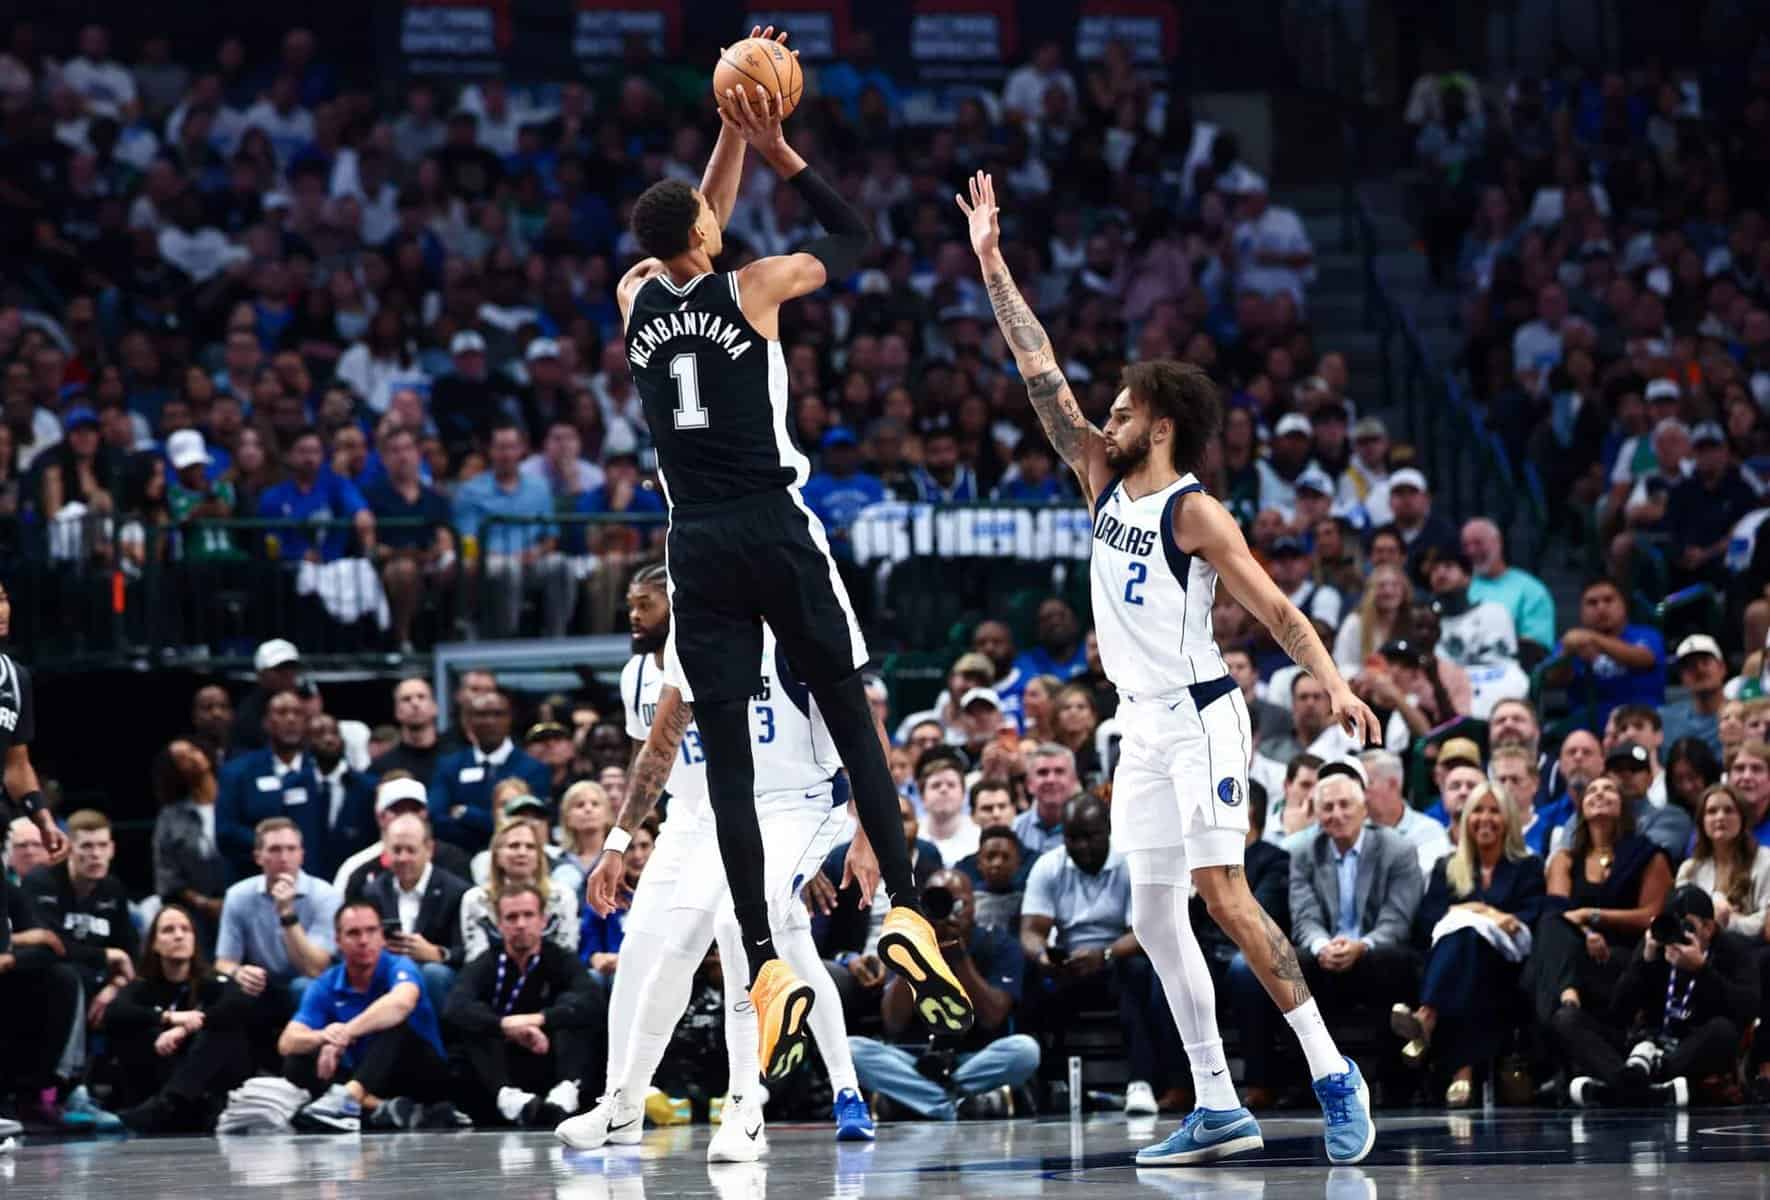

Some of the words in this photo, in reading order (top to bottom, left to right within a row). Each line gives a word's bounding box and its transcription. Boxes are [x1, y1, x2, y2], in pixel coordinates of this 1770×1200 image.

[630, 312, 752, 368] WEMBANYAMA
[669, 352, 710, 430] 1
[1094, 512, 1158, 557] DALLAS
[1124, 561, 1148, 606] 2
[755, 706, 776, 744] 3
